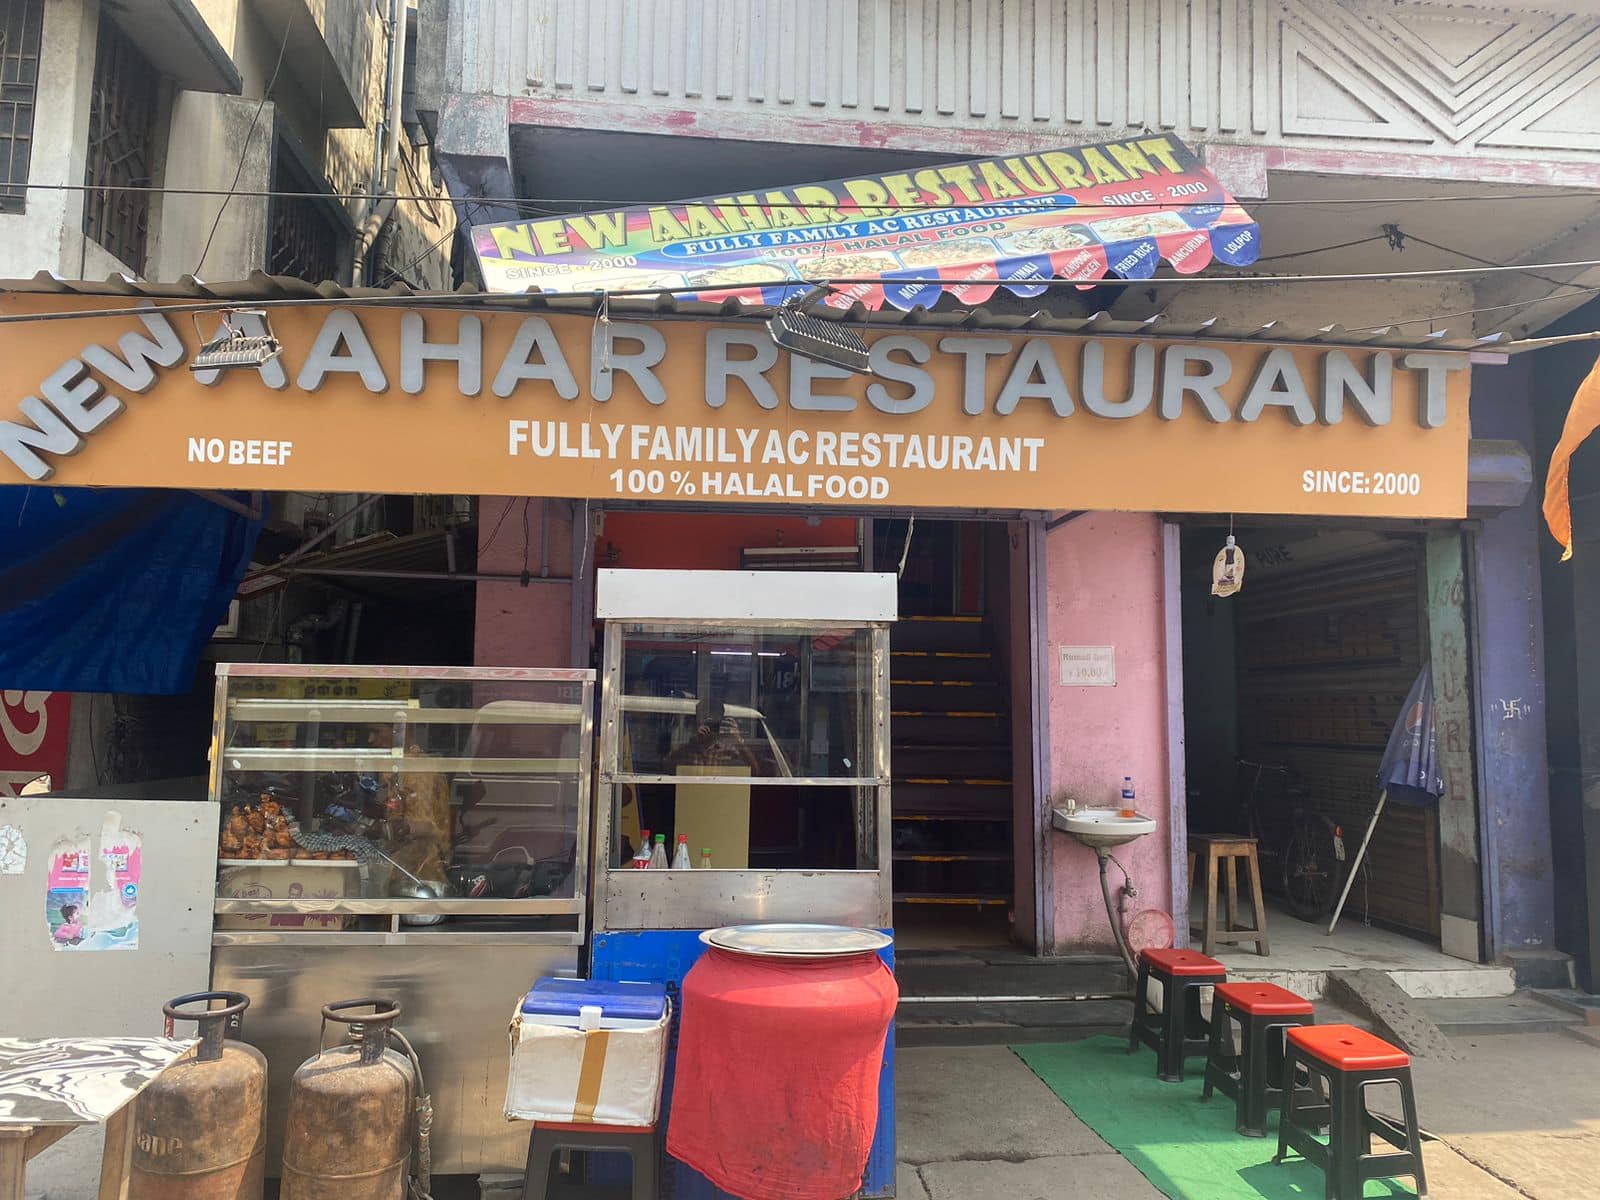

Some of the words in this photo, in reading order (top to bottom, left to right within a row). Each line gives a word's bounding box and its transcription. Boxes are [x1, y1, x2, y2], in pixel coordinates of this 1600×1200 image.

[490, 211, 627, 260] NEW
[649, 187, 848, 242] AAHAR
[843, 137, 1185, 218] RESTAURANT
[1103, 190, 1156, 206] SINCE
[1168, 182, 1208, 199] 2000
[686, 234, 763, 255] FULLY
[768, 224, 860, 245] FAMILY
[867, 221, 900, 236] AC
[901, 197, 1057, 229] RESTAURANT
[764, 245, 835, 258] 100%
[843, 233, 930, 251] HALAL
[936, 221, 1007, 239] FOOD
[506, 263, 571, 280] SINCE
[588, 255, 638, 272] 2000
[1114, 252, 1139, 275] FRIED
[1134, 241, 1155, 261] RICE
[0, 299, 187, 481] NEW
[704, 327, 1471, 430] RESTAURANT
[188, 437, 225, 463] NO
[228, 440, 293, 466] BEEF
[508, 419, 625, 459] FULLY
[630, 425, 756, 463] FAMILY
[761, 430, 809, 465] AC
[816, 432, 1045, 472] RESTAURANT
[609, 468, 665, 494] 100
[670, 470, 697, 496] %
[702, 470, 803, 497] HALAL
[808, 473, 890, 500] FOOD
